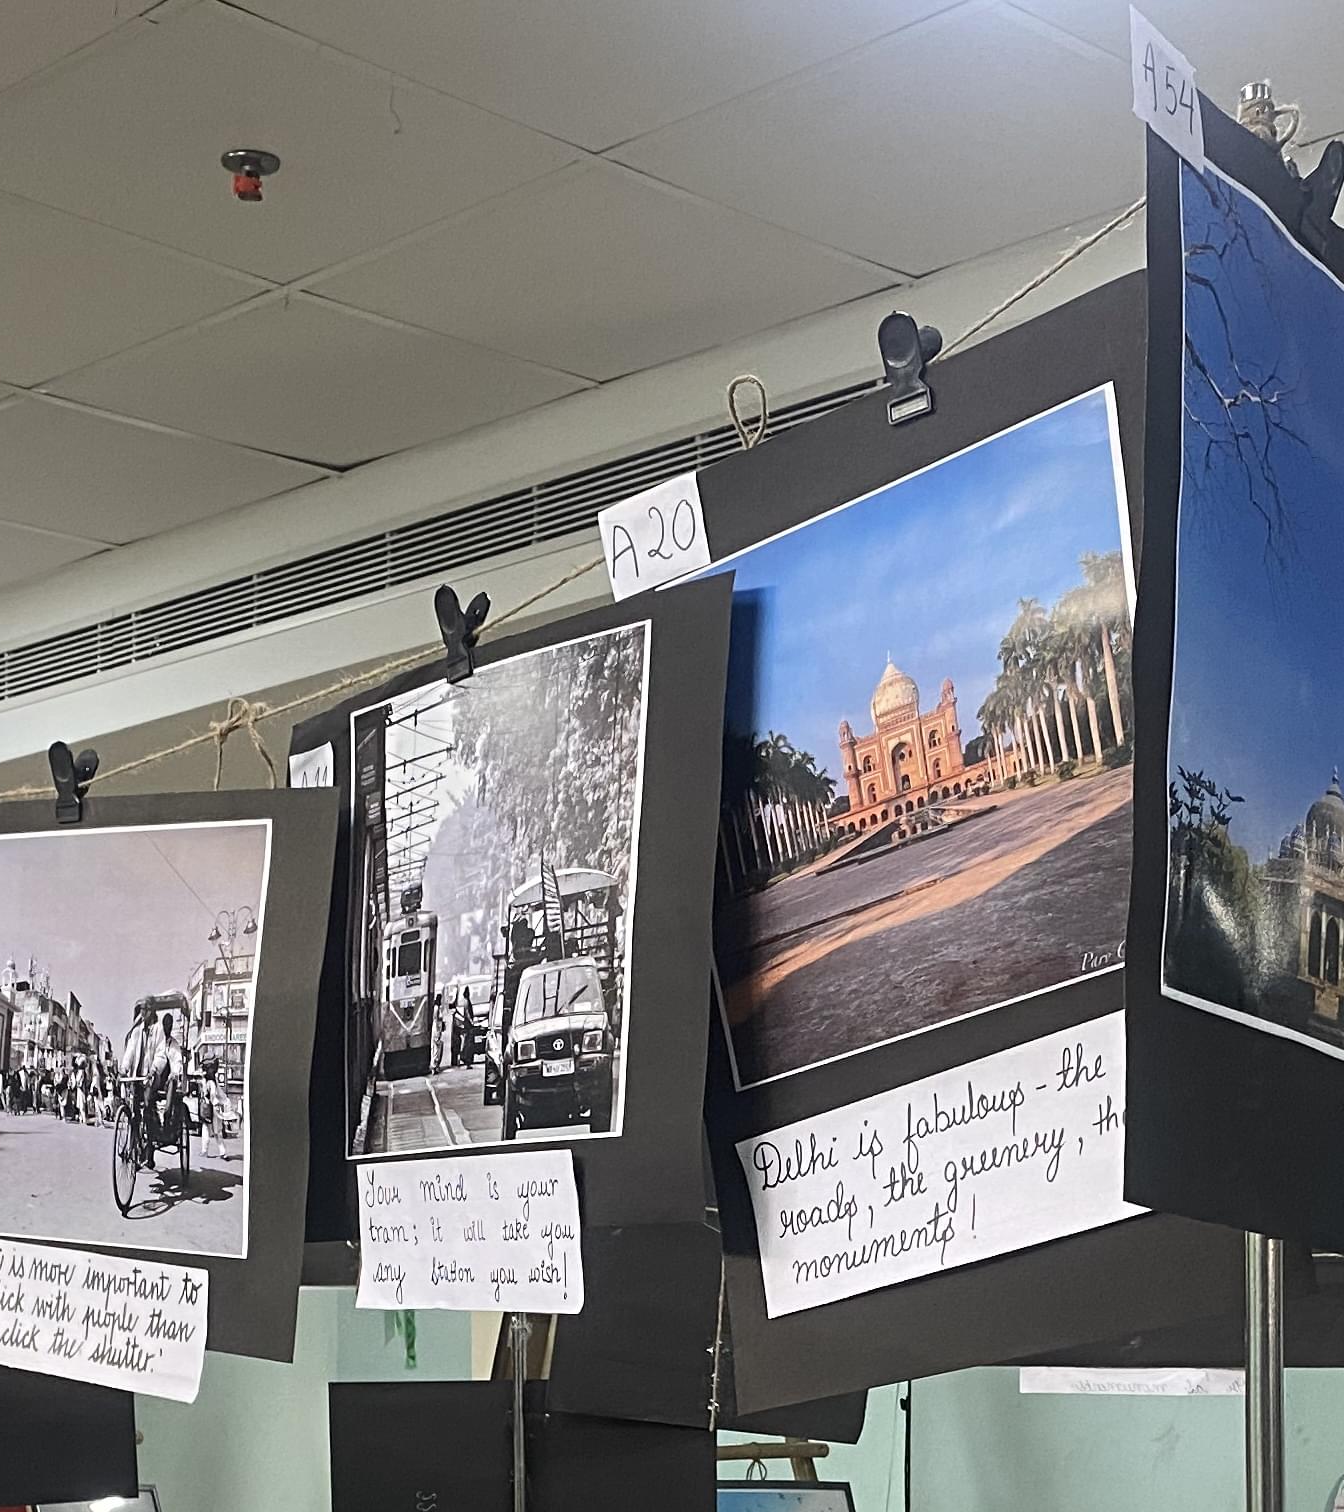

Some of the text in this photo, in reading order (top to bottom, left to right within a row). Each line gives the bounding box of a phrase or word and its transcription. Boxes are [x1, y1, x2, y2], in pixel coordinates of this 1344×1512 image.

[753, 1132, 840, 1192] Delhi
[852, 1120, 885, 1179] is
[903, 1081, 1025, 1174] fabulous
[1055, 1042, 1107, 1093] the
[882, 1166, 928, 1208] the
[1092, 1094, 1127, 1134] th
[365, 1169, 560, 1222] Your mind is your
[429, 1215, 445, 1244] it
[462, 1216, 488, 1243] will
[501, 1216, 532, 1242] take
[540, 1220, 576, 1260] you
[7, 1246, 26, 1279] is
[27, 1255, 77, 1287] more
[82, 1257, 173, 1311] important
[178, 1271, 204, 1306] to
[372, 1262, 407, 1306] any
[489, 1266, 520, 1303] you
[31, 1288, 78, 1324] with
[82, 1302, 140, 1347] people
[144, 1307, 197, 1343] than
[47, 1326, 85, 1361] the
